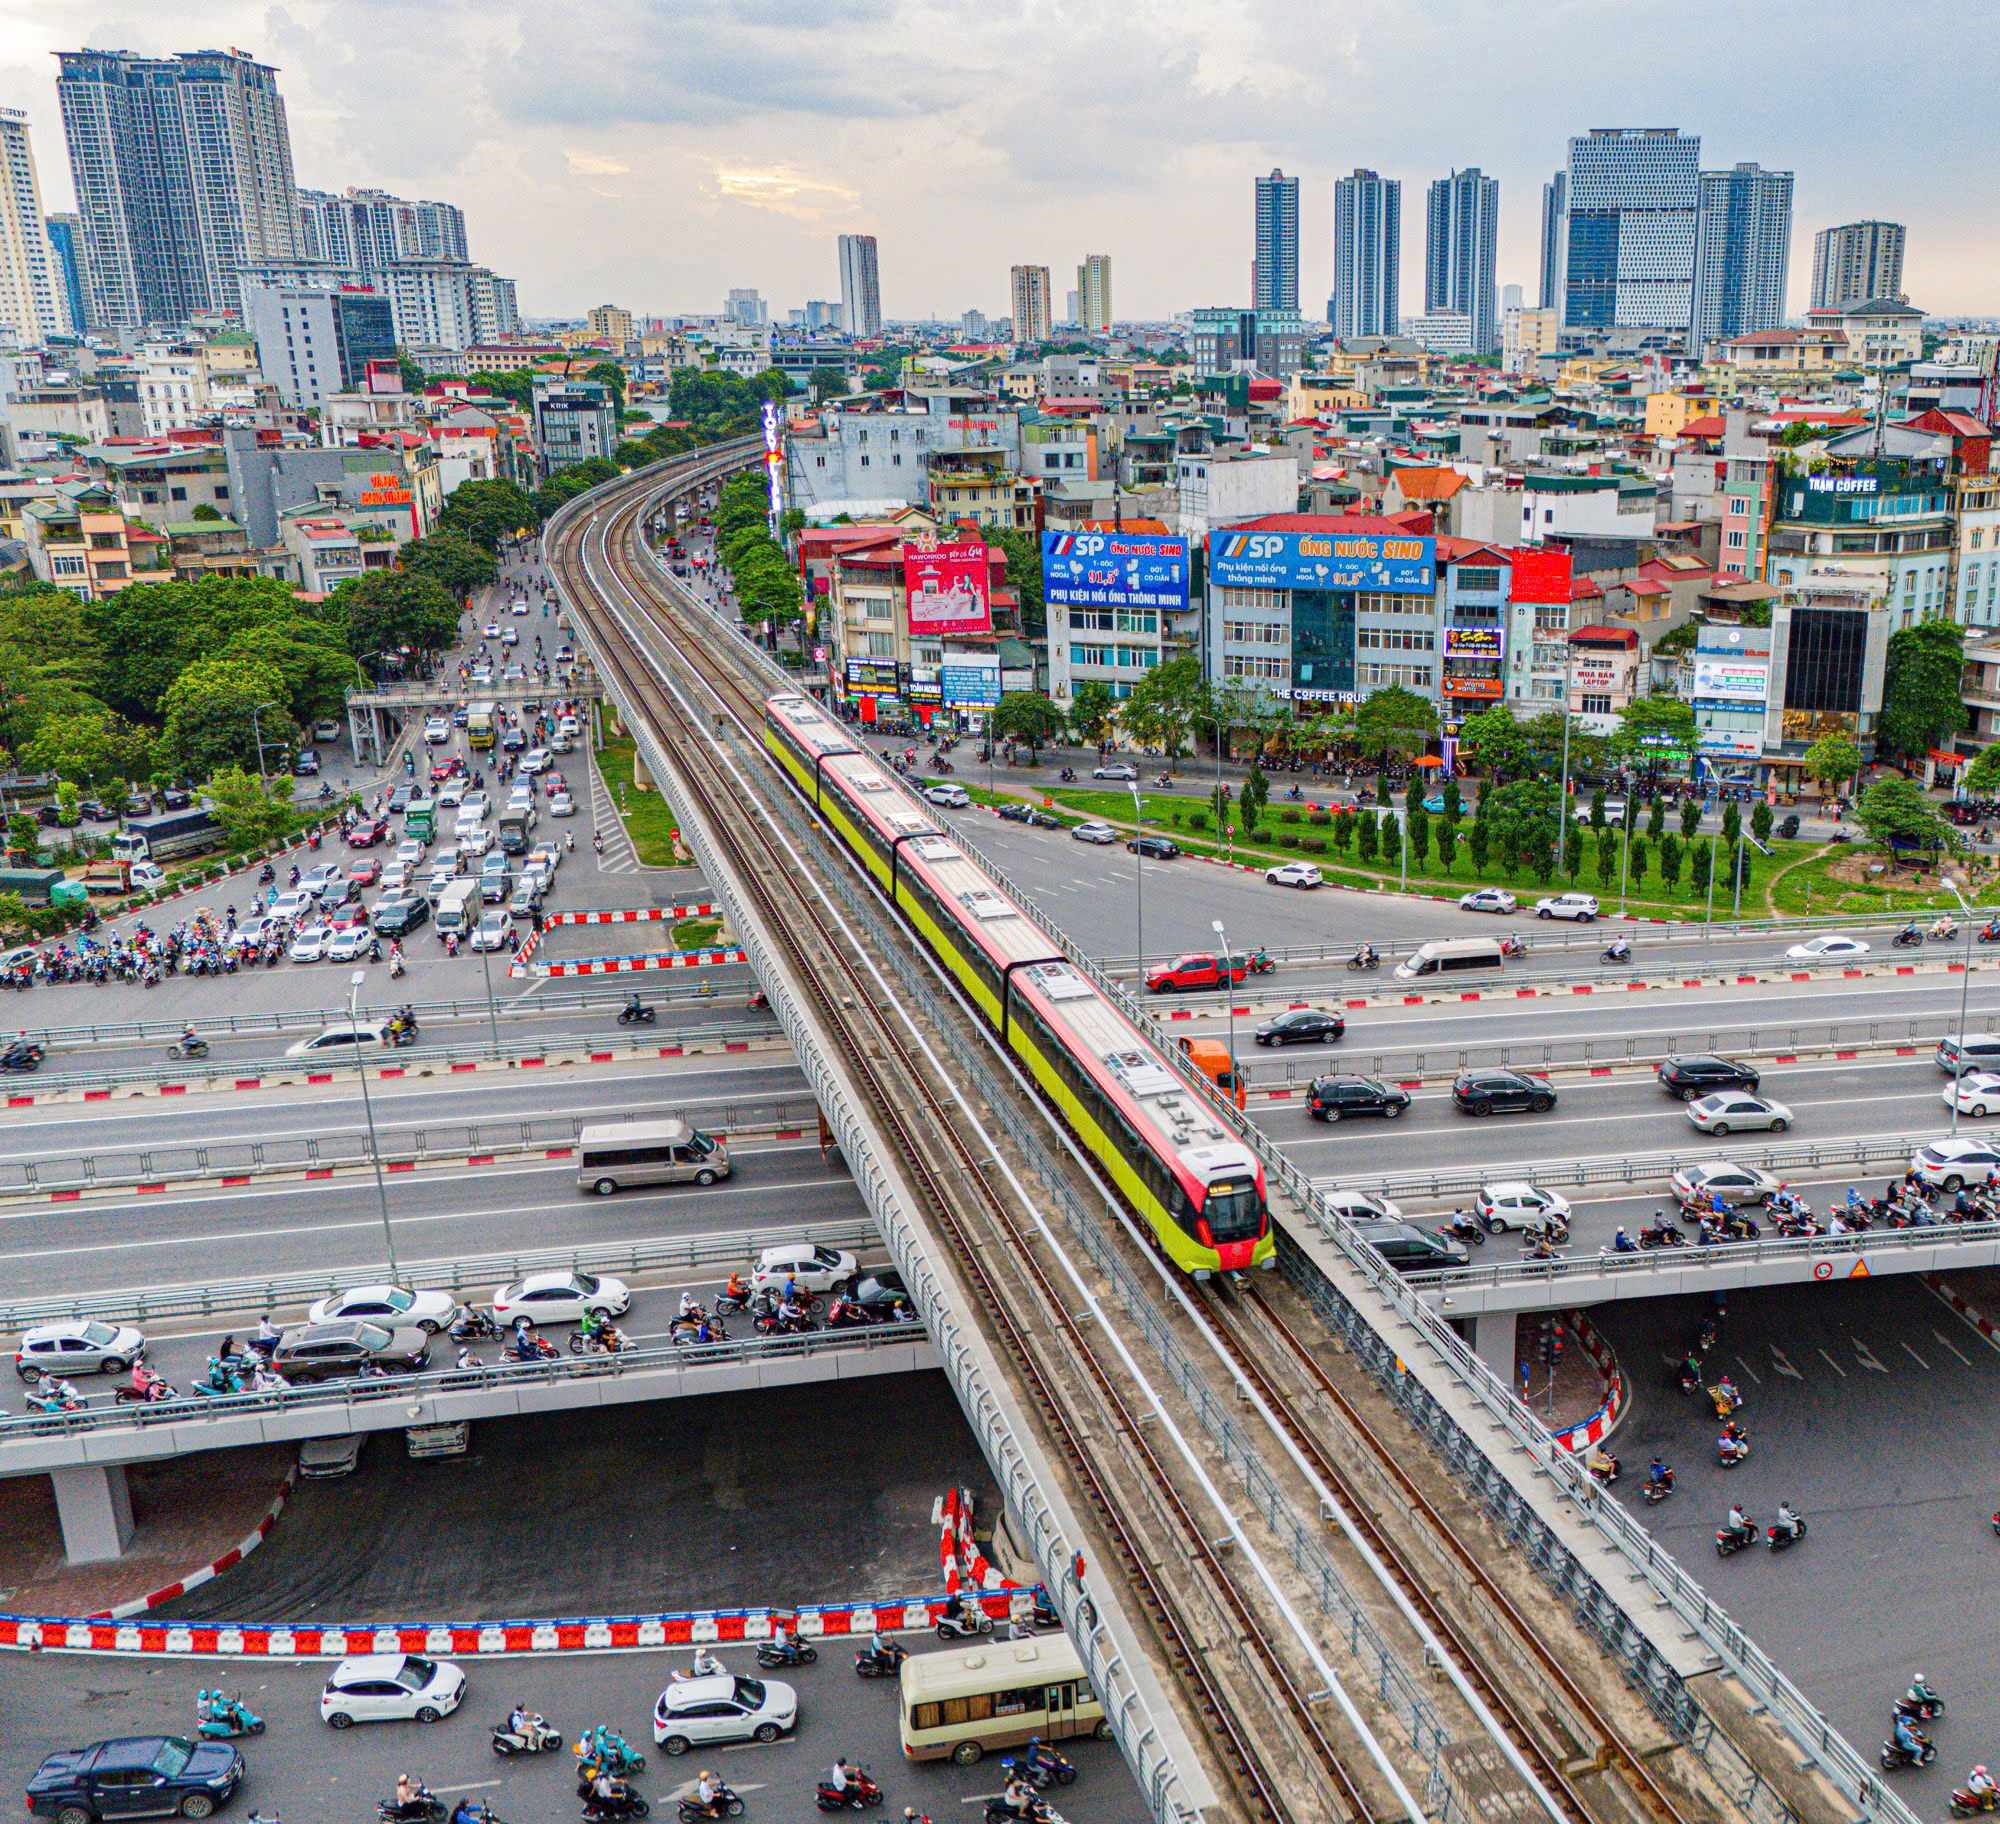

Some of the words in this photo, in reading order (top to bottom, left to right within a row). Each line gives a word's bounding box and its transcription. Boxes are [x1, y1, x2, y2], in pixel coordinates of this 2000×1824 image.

[587, 422, 596, 453] KRI
[1836, 478, 1877, 492] COFFEE
[1075, 536, 1105, 556] SP
[1159, 543, 1183, 556] SINO
[1249, 535, 1284, 558] SP
[1299, 535, 1331, 557] ỐNG
[1334, 538, 1378, 558] NƯỚC
[1382, 540, 1423, 561] SINO
[1217, 562, 1234, 573] Phụ
[1235, 562, 1254, 573] kiện
[1255, 562, 1269, 573] nối
[1269, 563, 1287, 574] ống
[1227, 574, 1253, 583] thông
[1254, 575, 1276, 583] minh
[1050, 589, 1068, 603] PHỤ
[1070, 589, 1090, 603] KIỆN
[1091, 588, 1106, 602] NỐI
[1108, 589, 1126, 603] ỐNG
[1128, 592, 1156, 605] THÔNG
[1158, 595, 1182, 606] MINH
[1271, 688, 1291, 699] THE
[1293, 690, 1335, 702] COFFEE
[1338, 692, 1371, 704] HOUS
